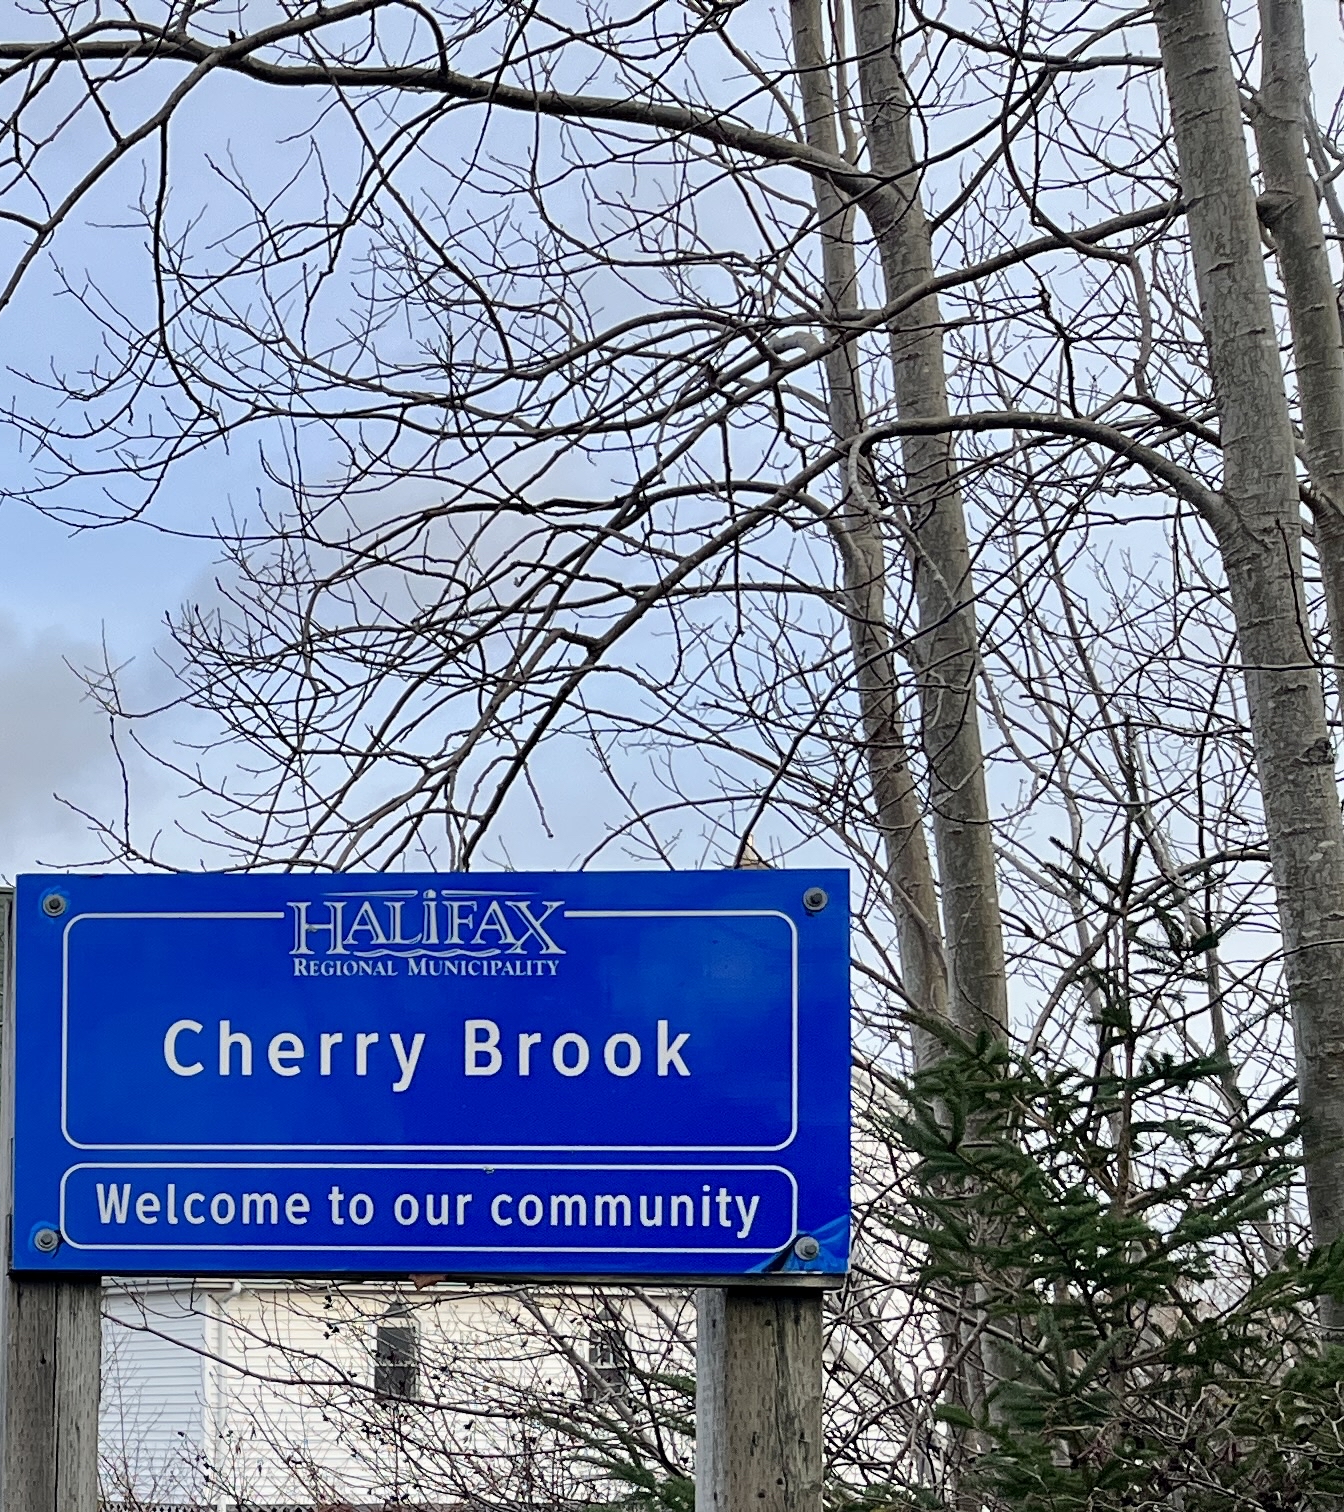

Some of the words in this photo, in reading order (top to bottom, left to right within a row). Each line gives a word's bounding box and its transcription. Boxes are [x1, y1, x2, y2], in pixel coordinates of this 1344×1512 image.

[163, 1019, 426, 1092] Cherry
[463, 1019, 692, 1078] Brook
[96, 1182, 312, 1226] Welcome
[328, 1186, 372, 1226] to
[393, 1194, 473, 1227] our
[490, 1184, 761, 1239] community
